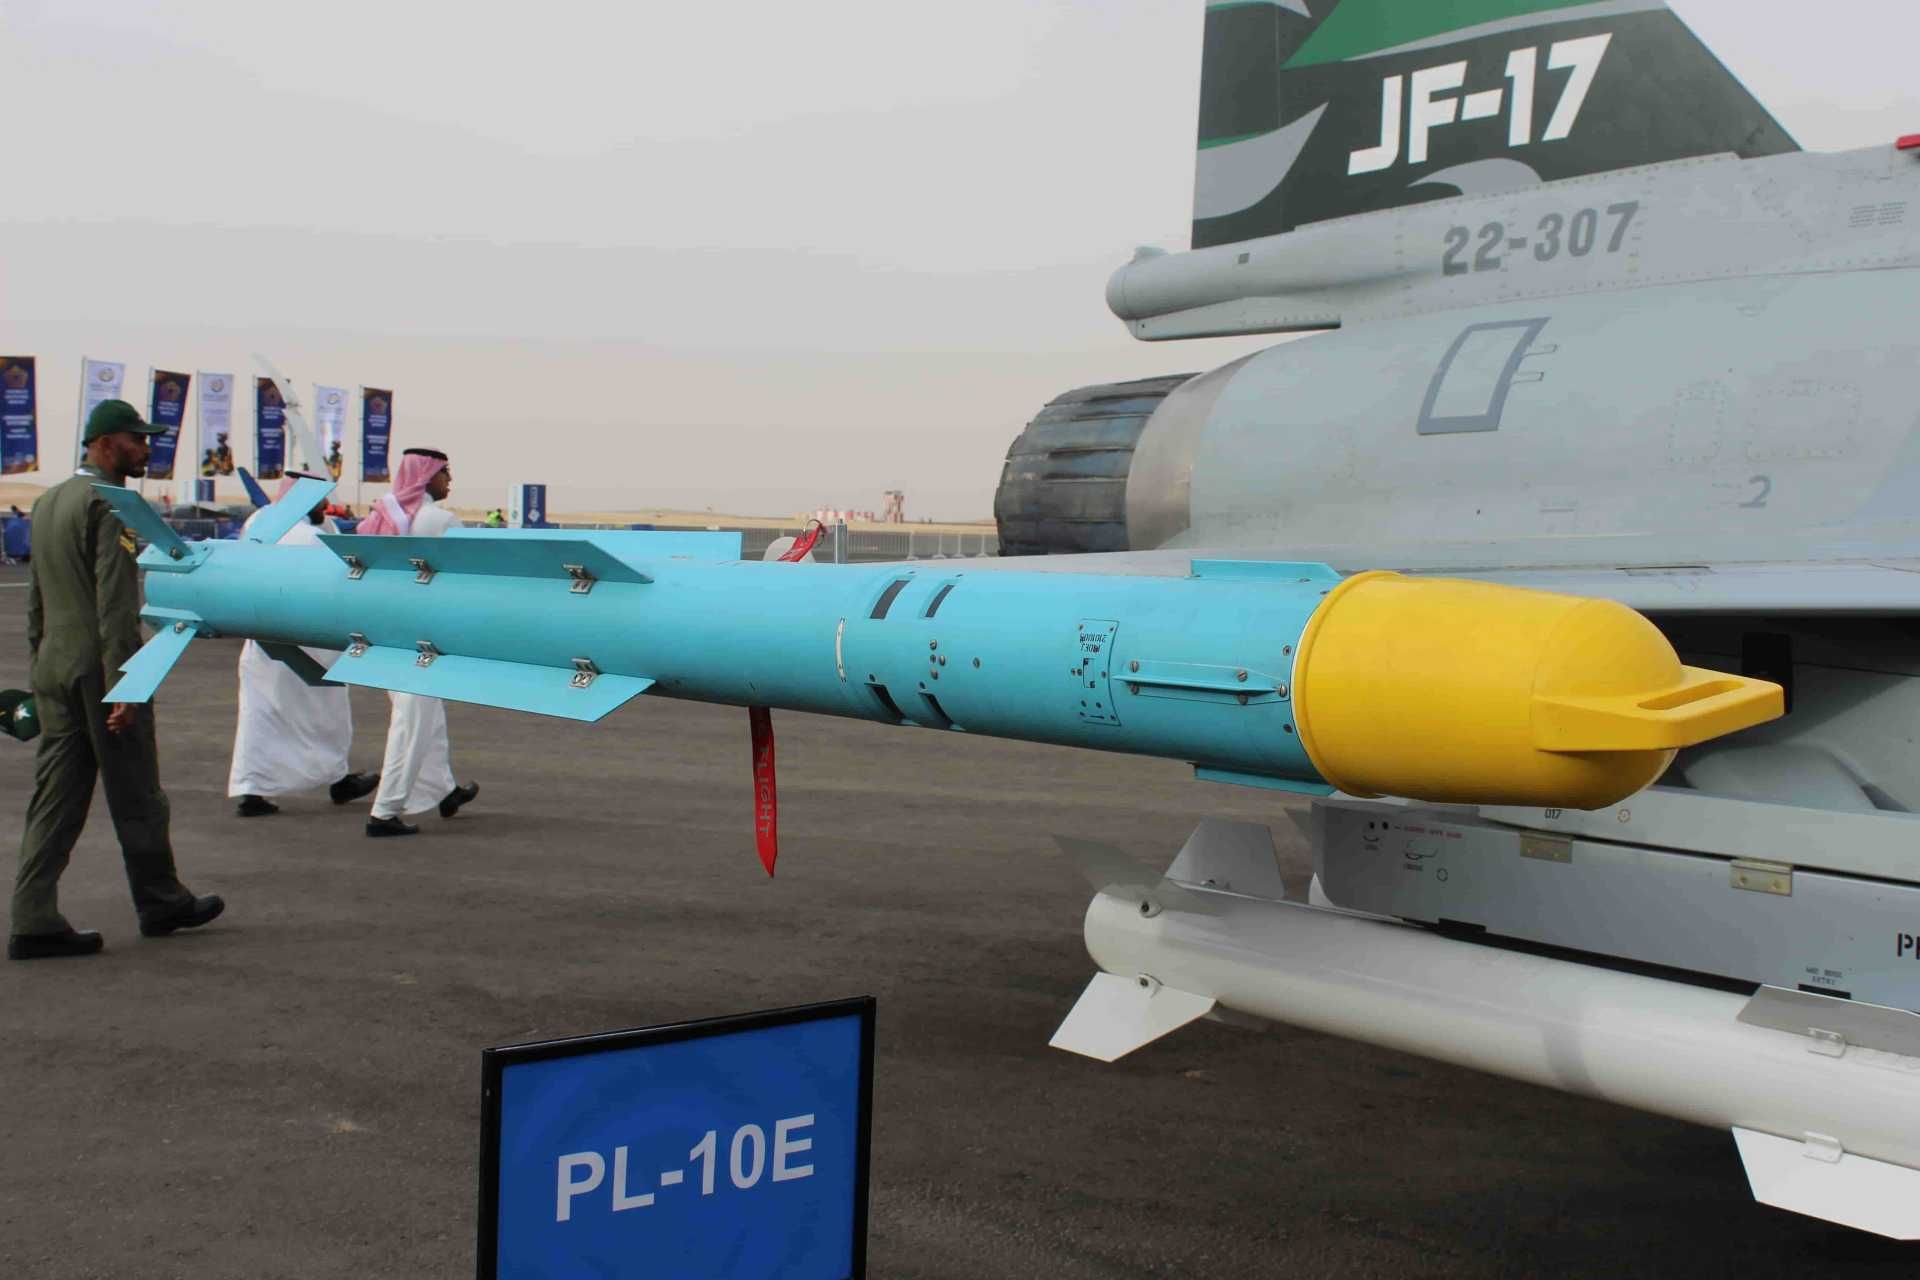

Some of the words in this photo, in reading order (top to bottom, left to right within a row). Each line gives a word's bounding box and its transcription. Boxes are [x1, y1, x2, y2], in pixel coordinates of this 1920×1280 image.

[1347, 33, 1613, 176] JF-17
[1442, 201, 1640, 277] 22-307
[1737, 474, 1772, 509] 2
[556, 1113, 815, 1223] PL-10E
